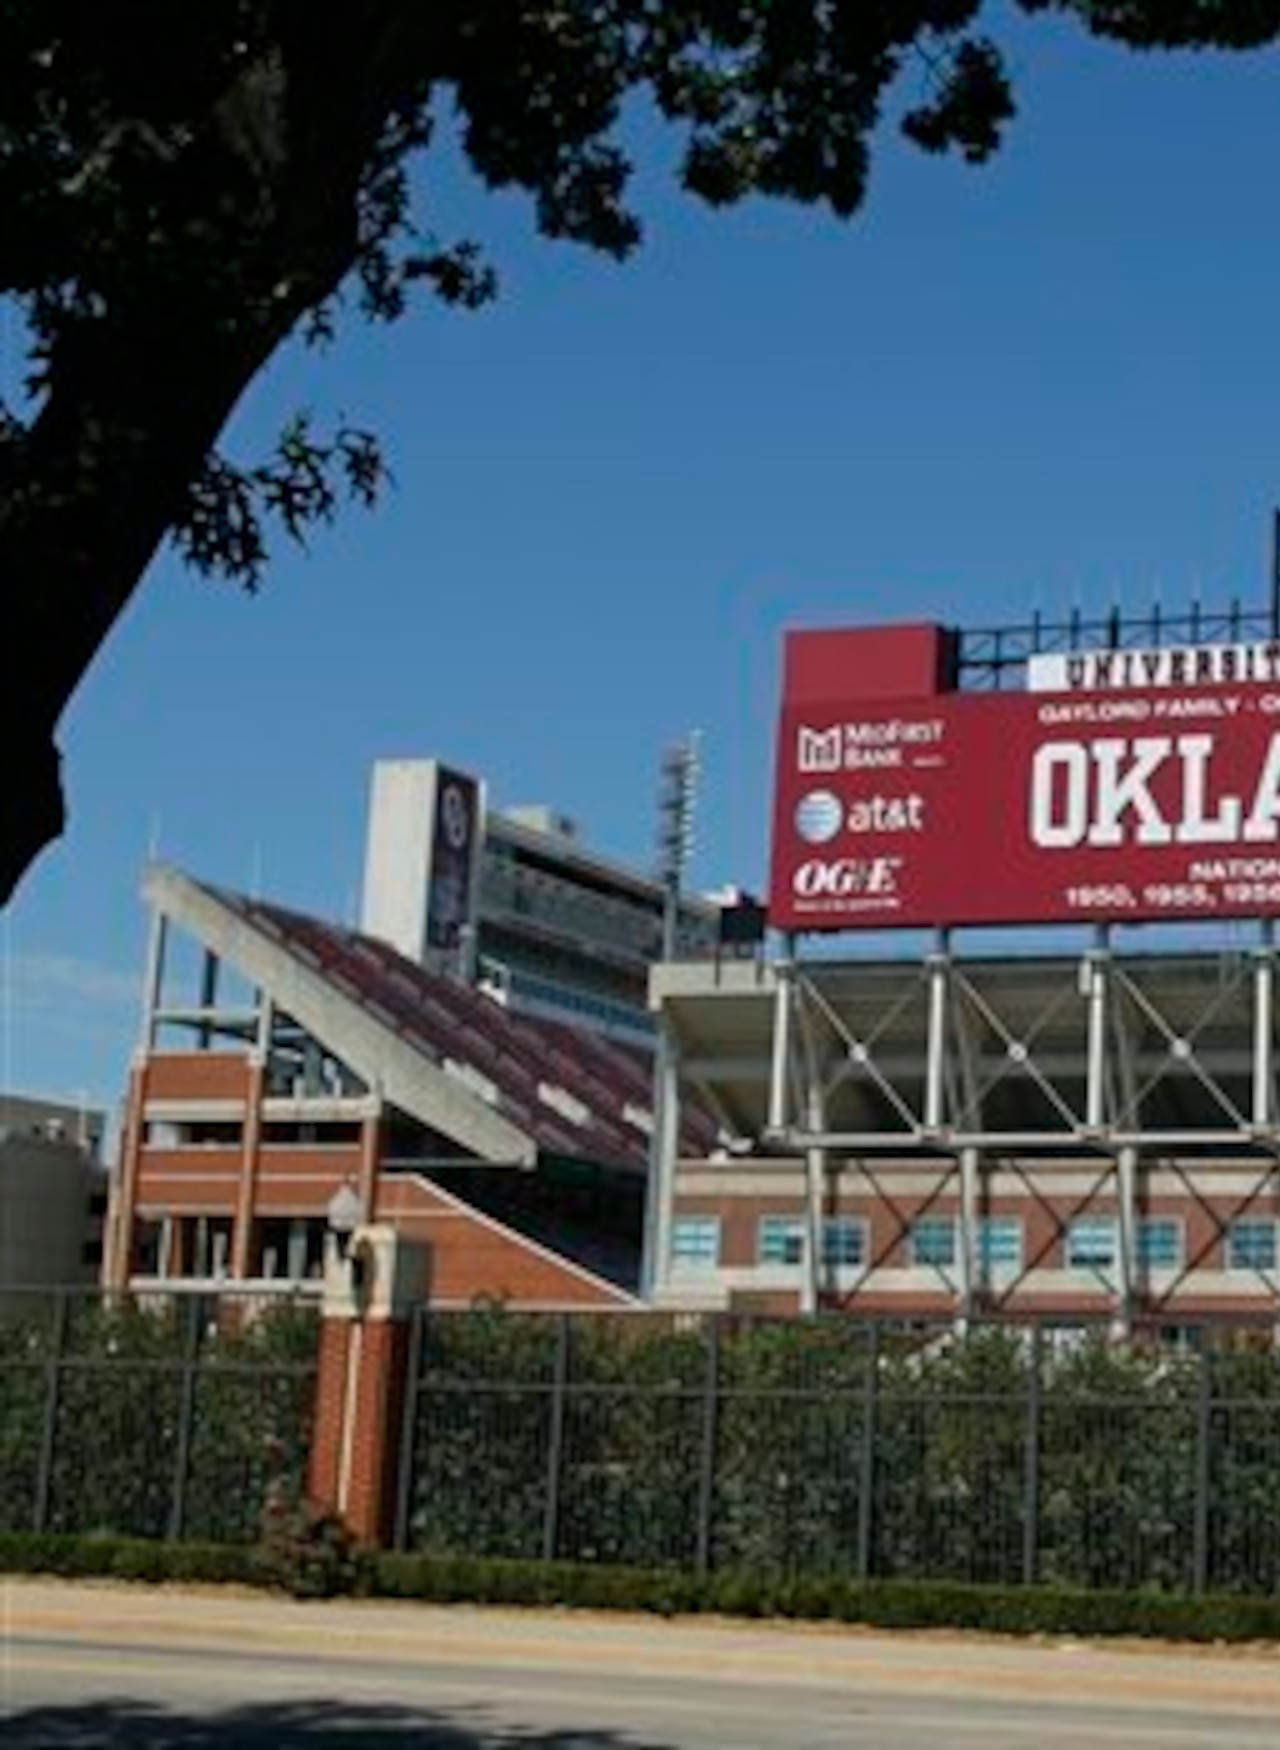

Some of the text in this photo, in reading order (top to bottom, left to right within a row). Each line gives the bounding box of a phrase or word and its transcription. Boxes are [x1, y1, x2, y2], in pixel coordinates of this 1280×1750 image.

[1038, 703, 1150, 724] GAYLORD
[1155, 696, 1242, 718] FAMILY
[844, 748, 901, 771] BANK
